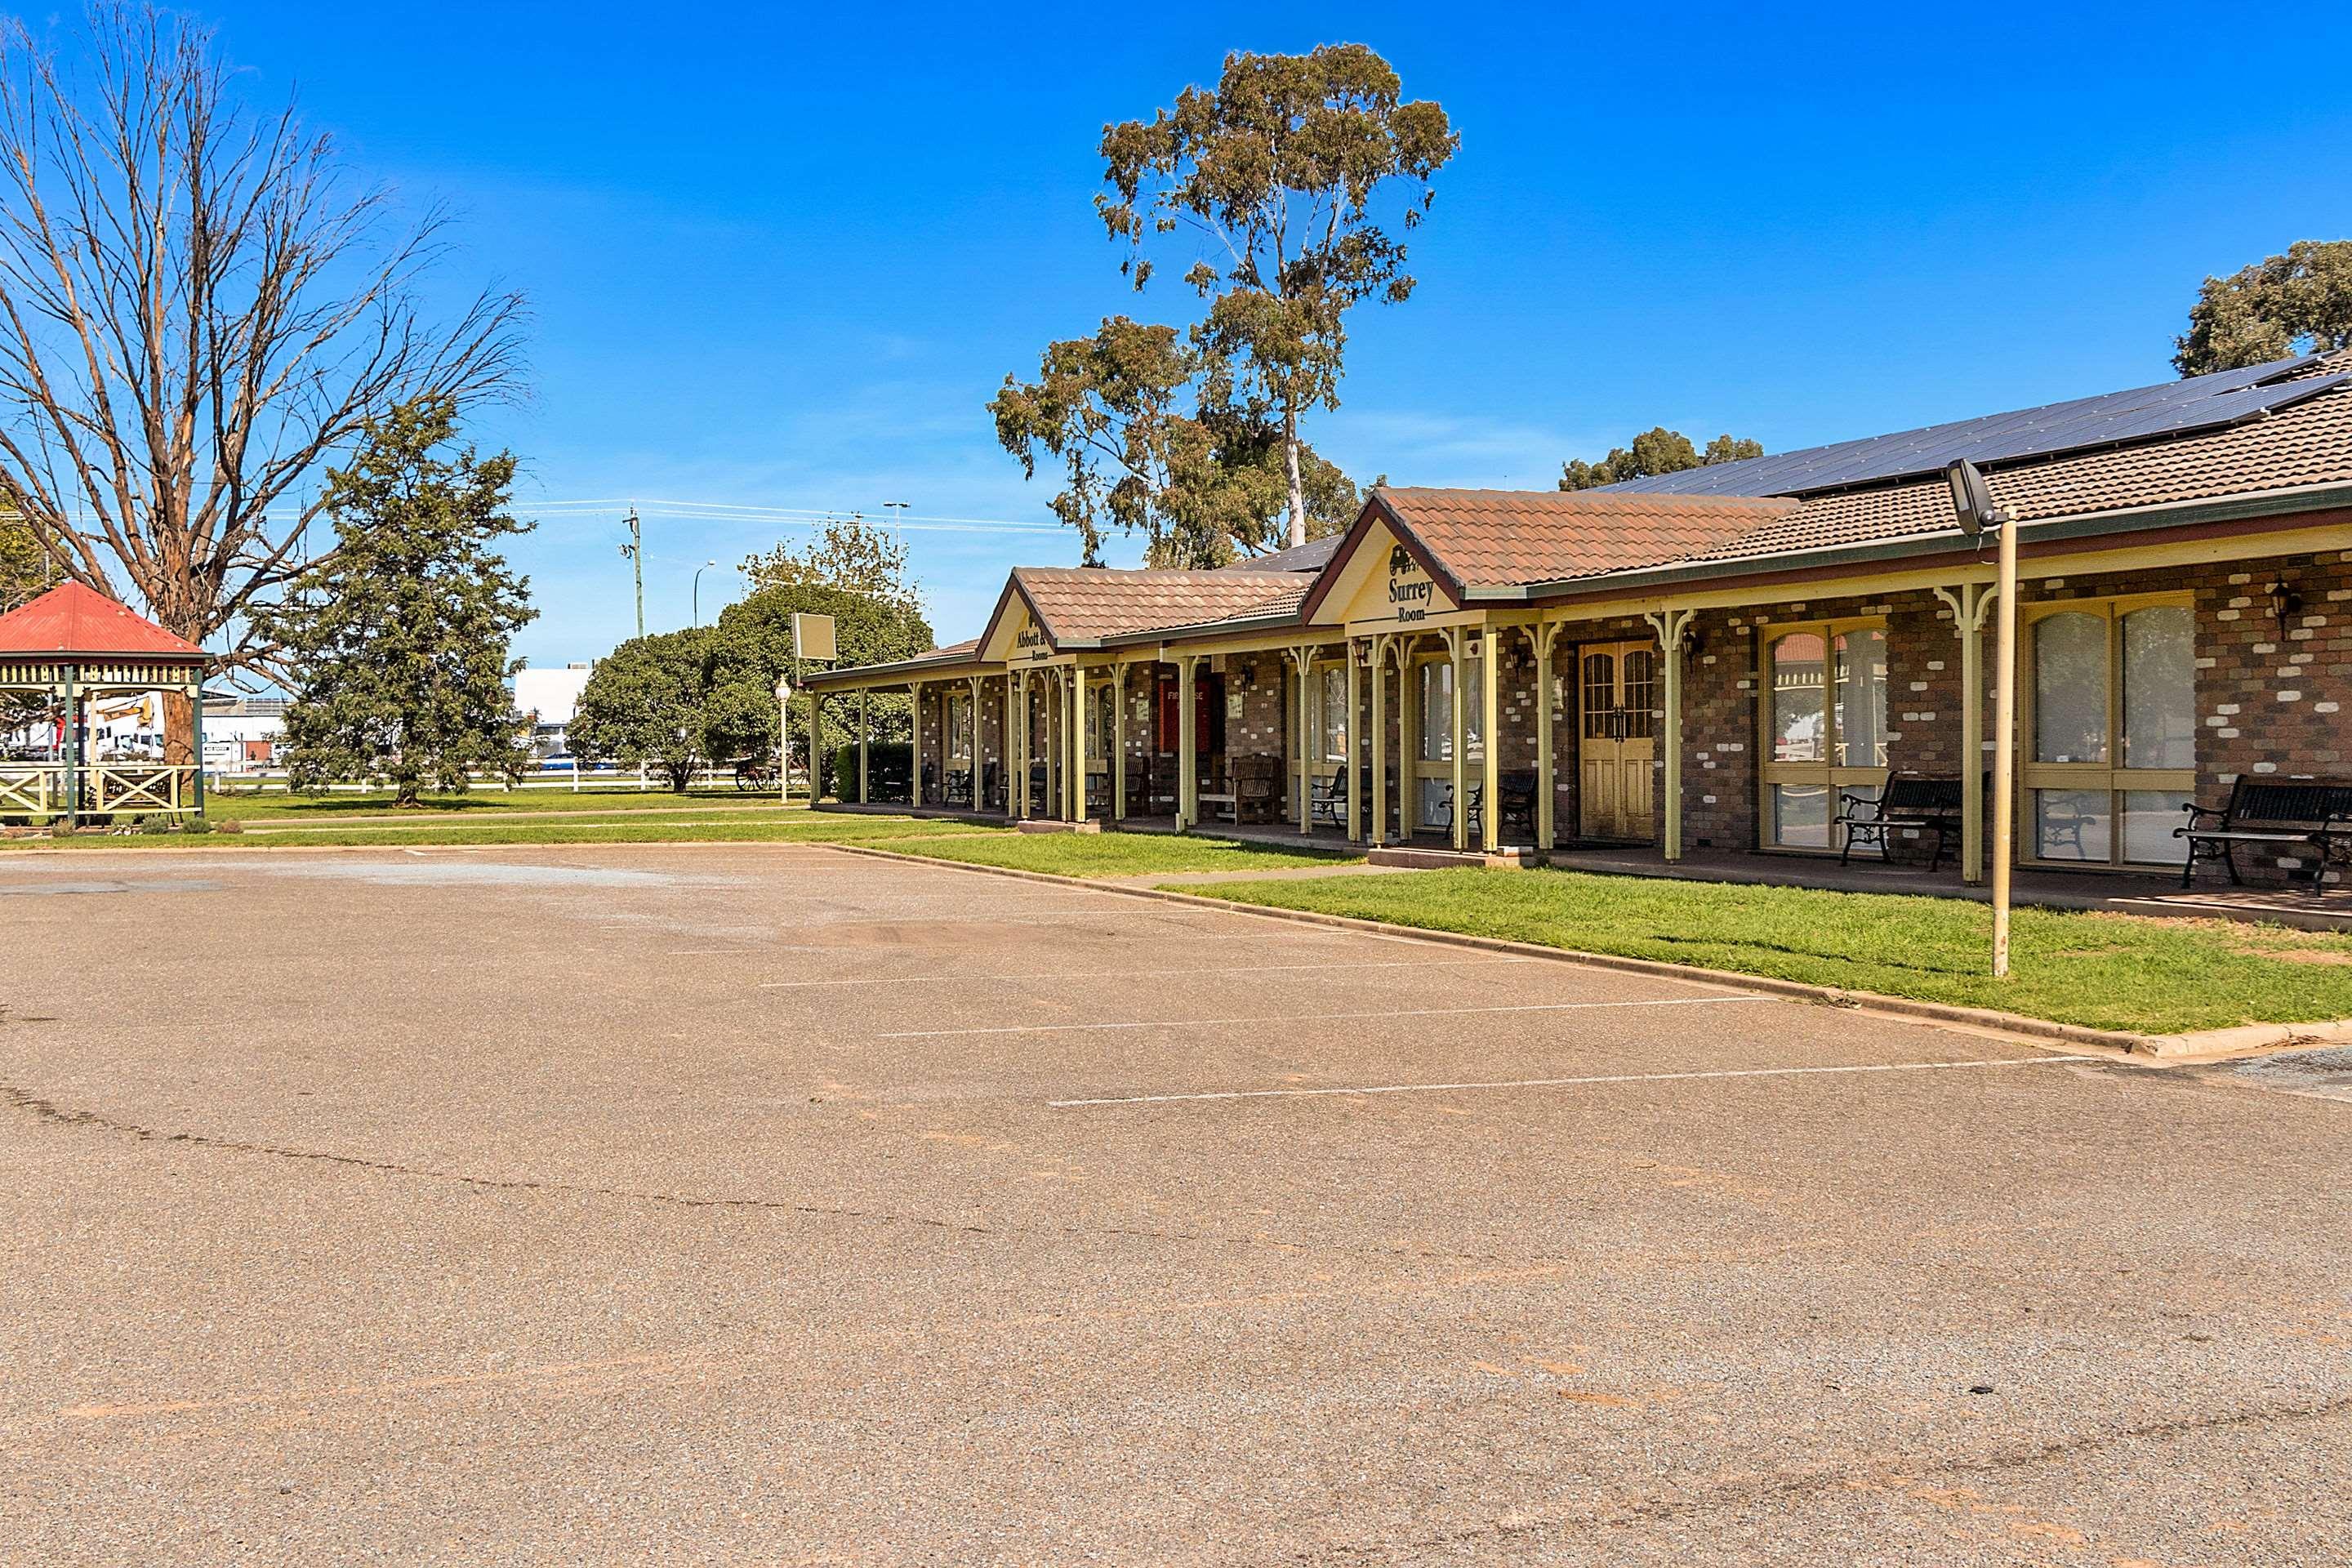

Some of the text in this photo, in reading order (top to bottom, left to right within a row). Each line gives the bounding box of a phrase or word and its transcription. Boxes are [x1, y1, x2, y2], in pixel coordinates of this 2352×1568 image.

[1389, 579, 1433, 606] Surrey
[1398, 607, 1425, 622] Room
[1017, 630, 1039, 648] Abbott
[1168, 692, 1180, 700] FIR
